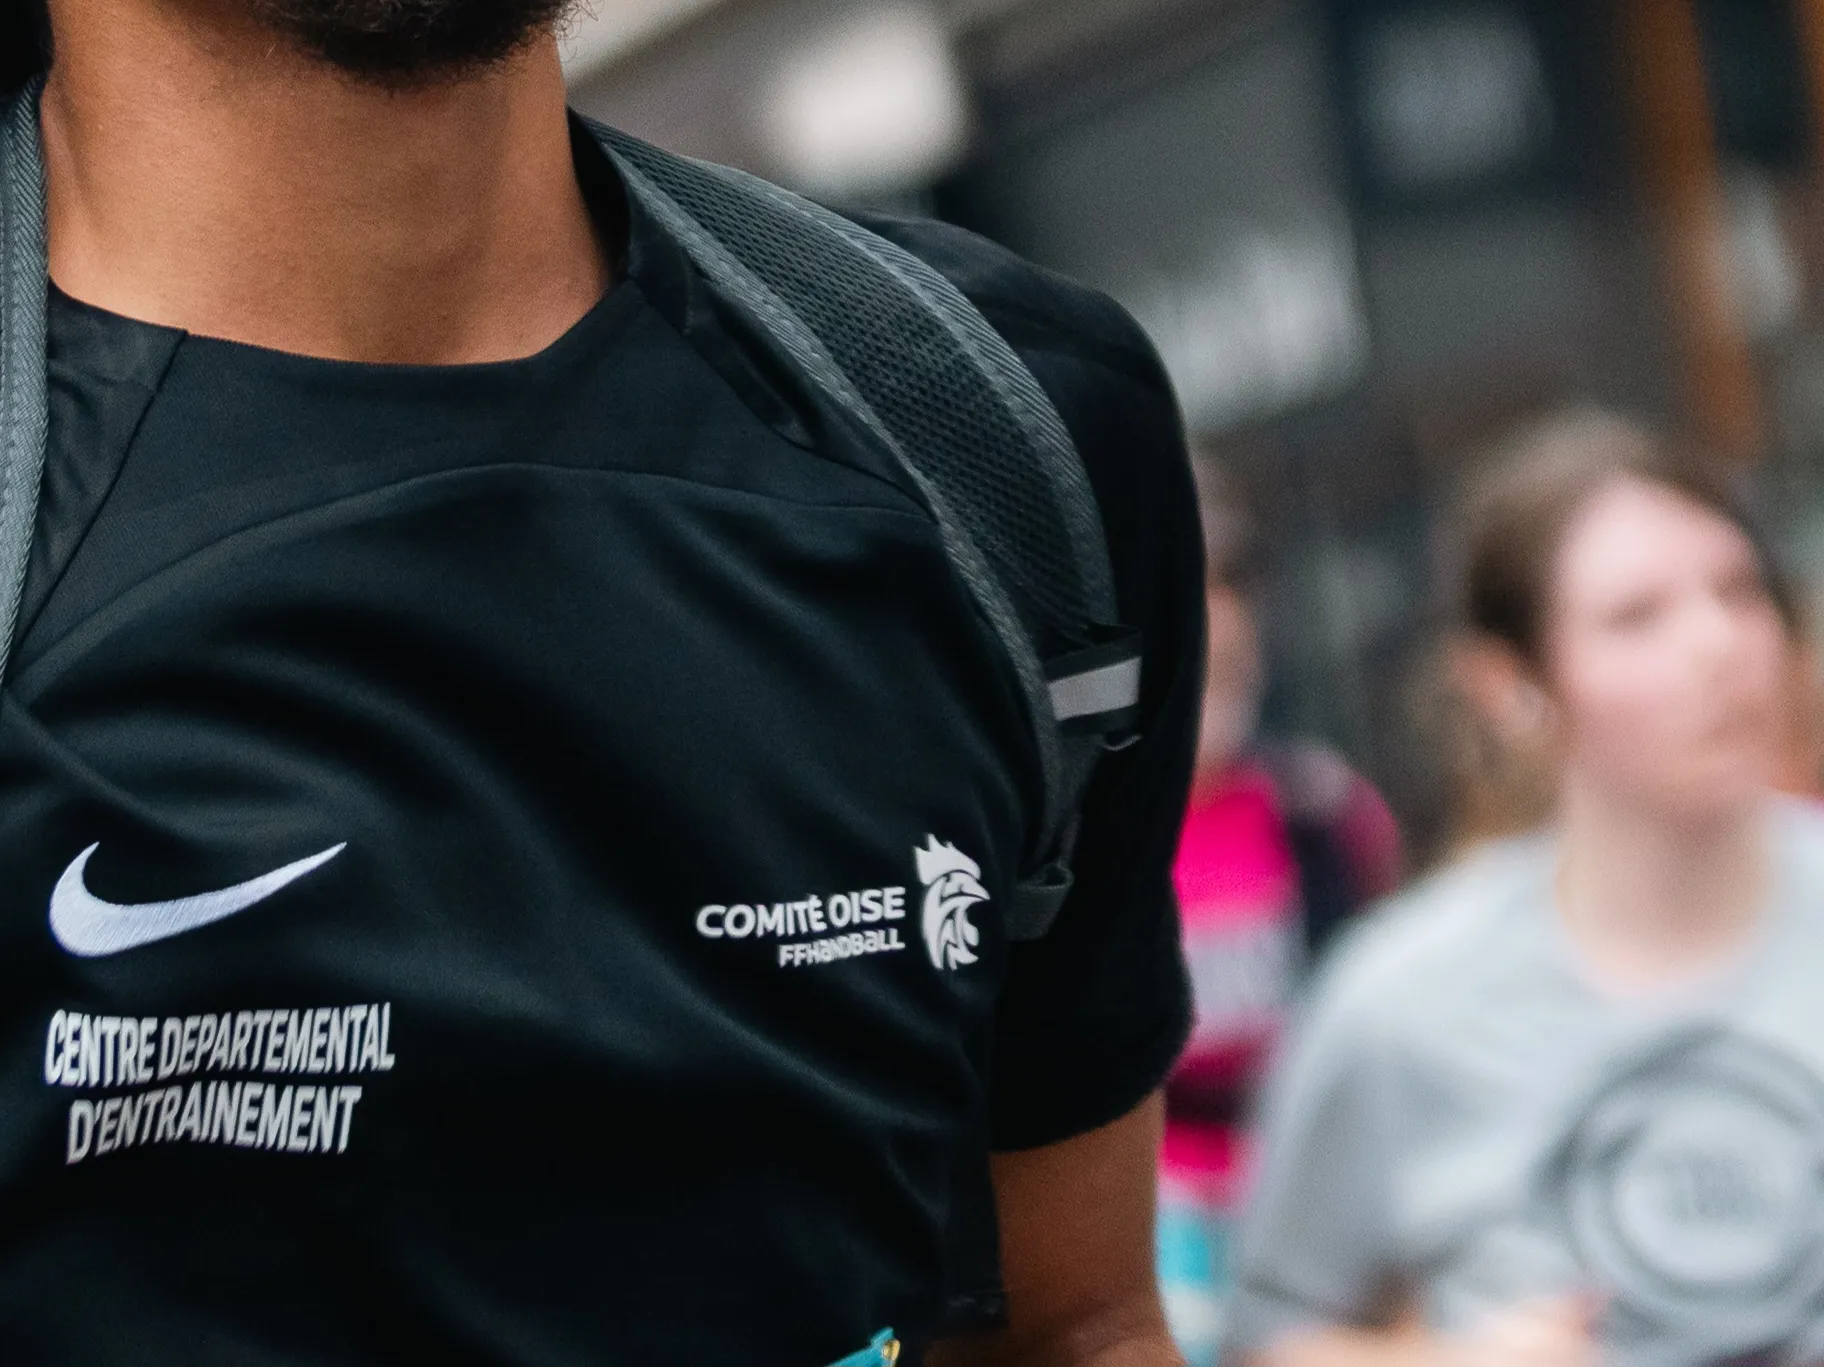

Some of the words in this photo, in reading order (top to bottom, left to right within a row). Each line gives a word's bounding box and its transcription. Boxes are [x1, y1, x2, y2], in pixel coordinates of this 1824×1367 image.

[696, 894, 828, 938] COMITÉ
[828, 886, 906, 929] OISE
[44, 1009, 159, 1088] CENTRE
[157, 1001, 396, 1081] DEPARTEMENTAL
[66, 1080, 363, 1164] D'ENTRAINEMENT
